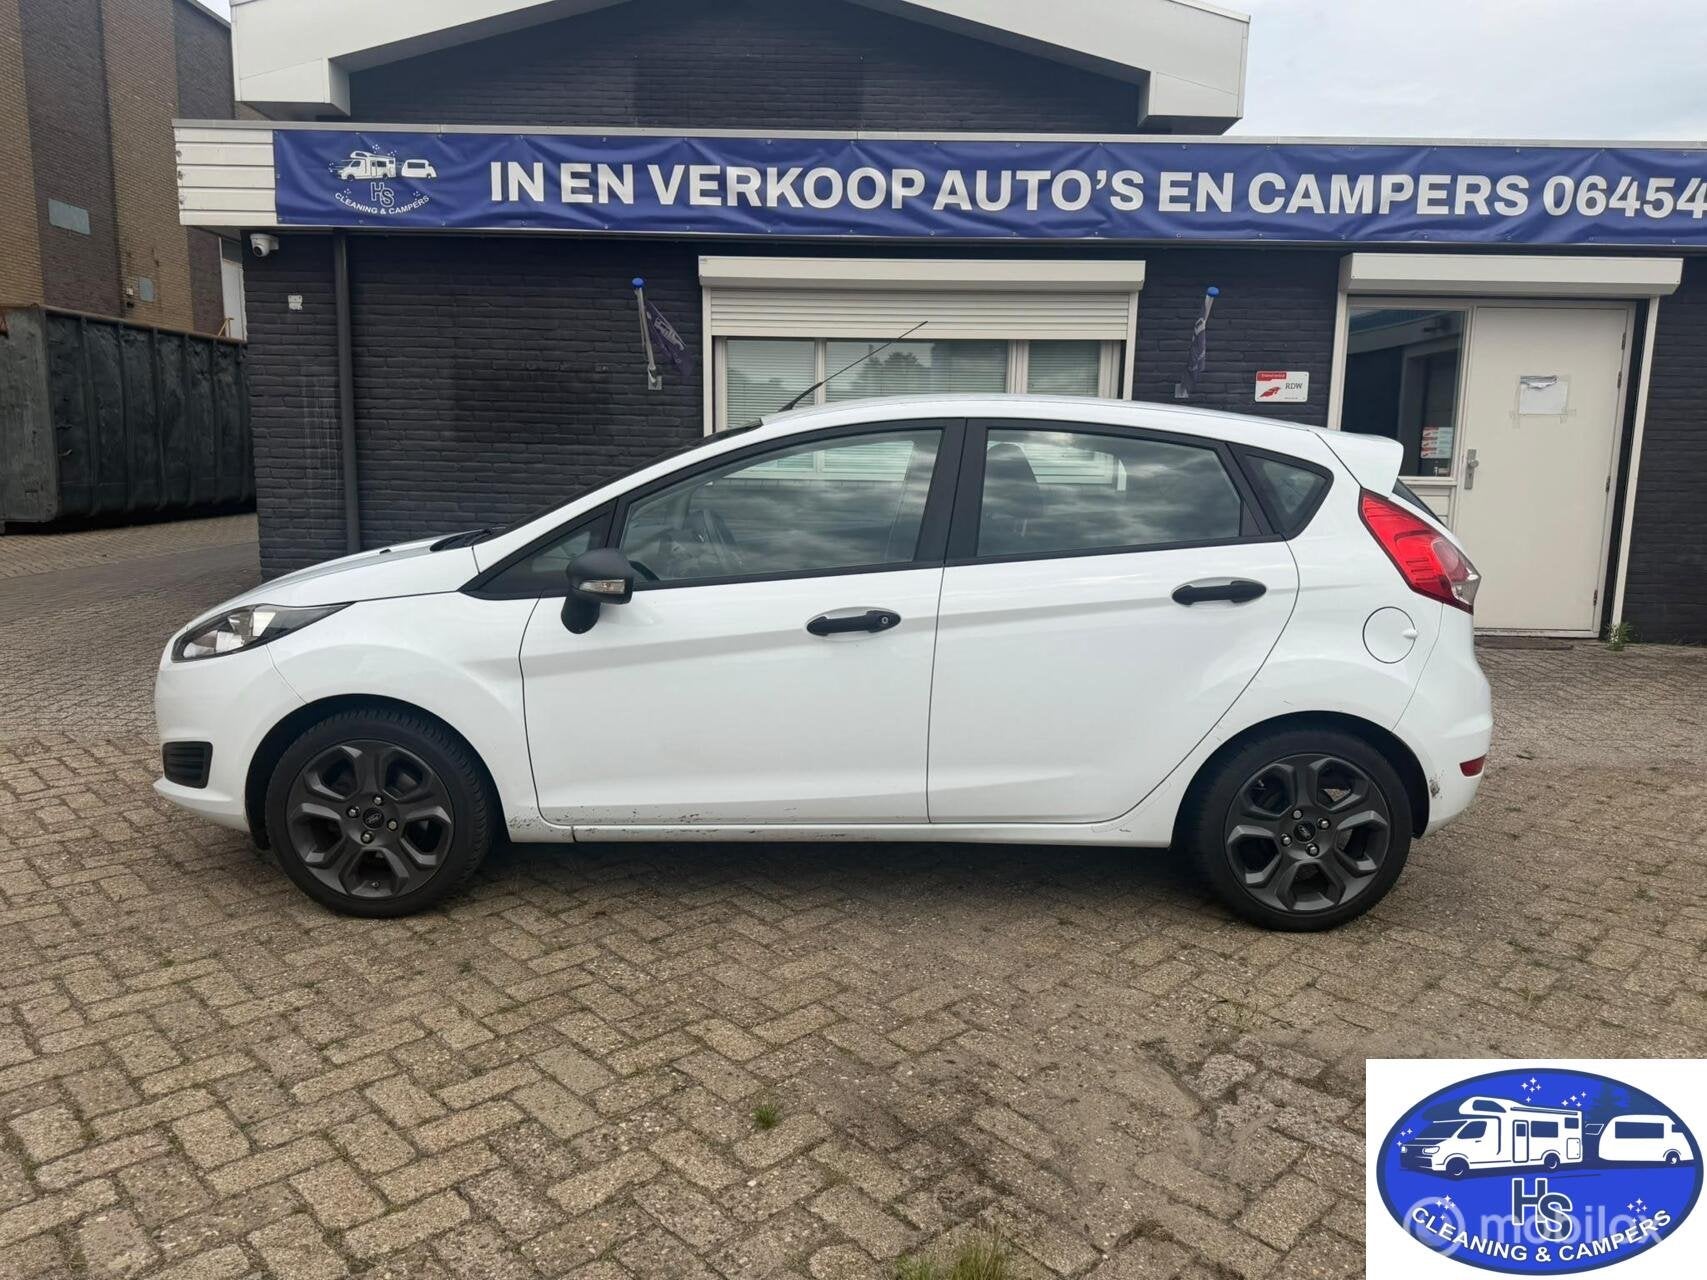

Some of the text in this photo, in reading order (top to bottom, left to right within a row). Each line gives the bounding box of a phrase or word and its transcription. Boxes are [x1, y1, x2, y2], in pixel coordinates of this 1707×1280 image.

[370, 182, 394, 207] HS
[490, 161, 544, 202] IN
[560, 163, 634, 204] EN
[647, 164, 926, 209] VERKOOP
[933, 169, 1144, 211] AUTO’S
[1158, 171, 1234, 213] EN
[1248, 172, 1529, 217] CAMPERS
[335, 193, 377, 214] CLEANING
[389, 195, 429, 214] CAMPERS
